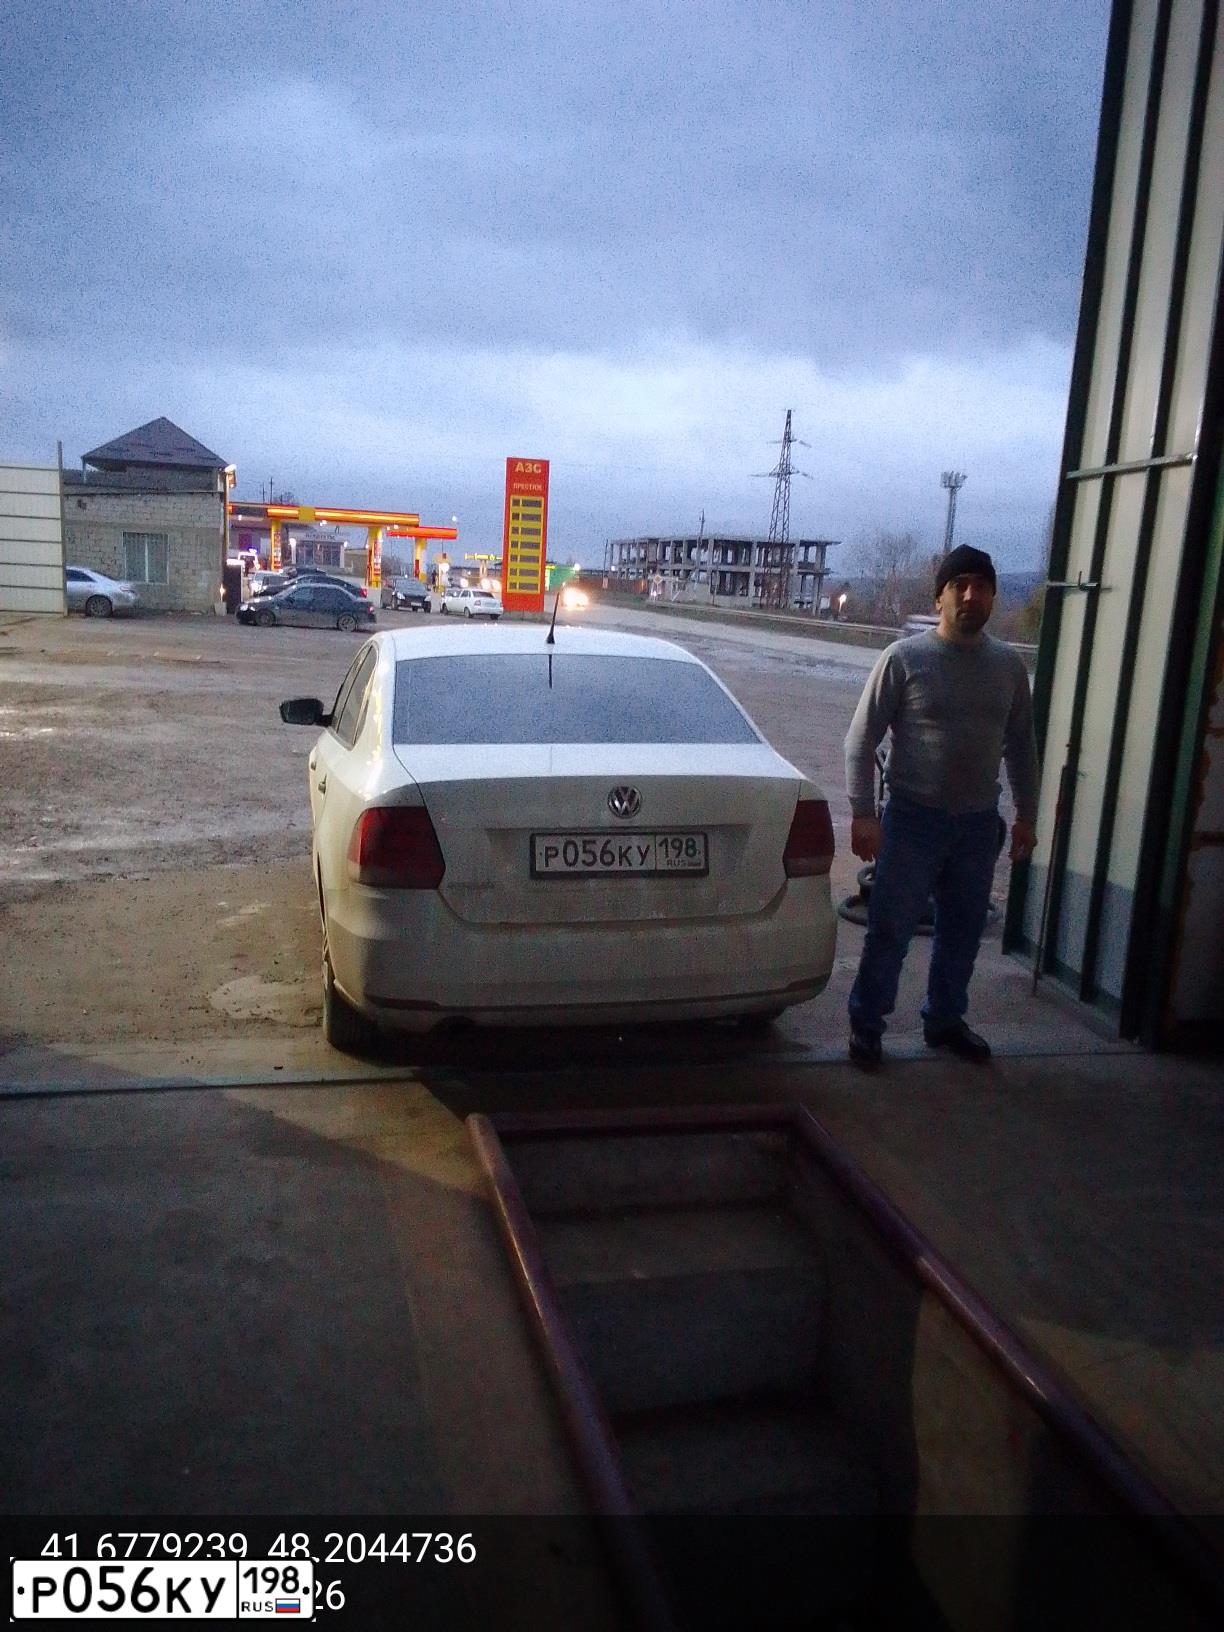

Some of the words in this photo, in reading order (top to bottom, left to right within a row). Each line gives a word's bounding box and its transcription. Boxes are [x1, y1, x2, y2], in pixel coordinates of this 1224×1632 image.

[514, 461, 542, 474] АЗС
[658, 837, 697, 859] 198
[667, 859, 687, 867] RUS
